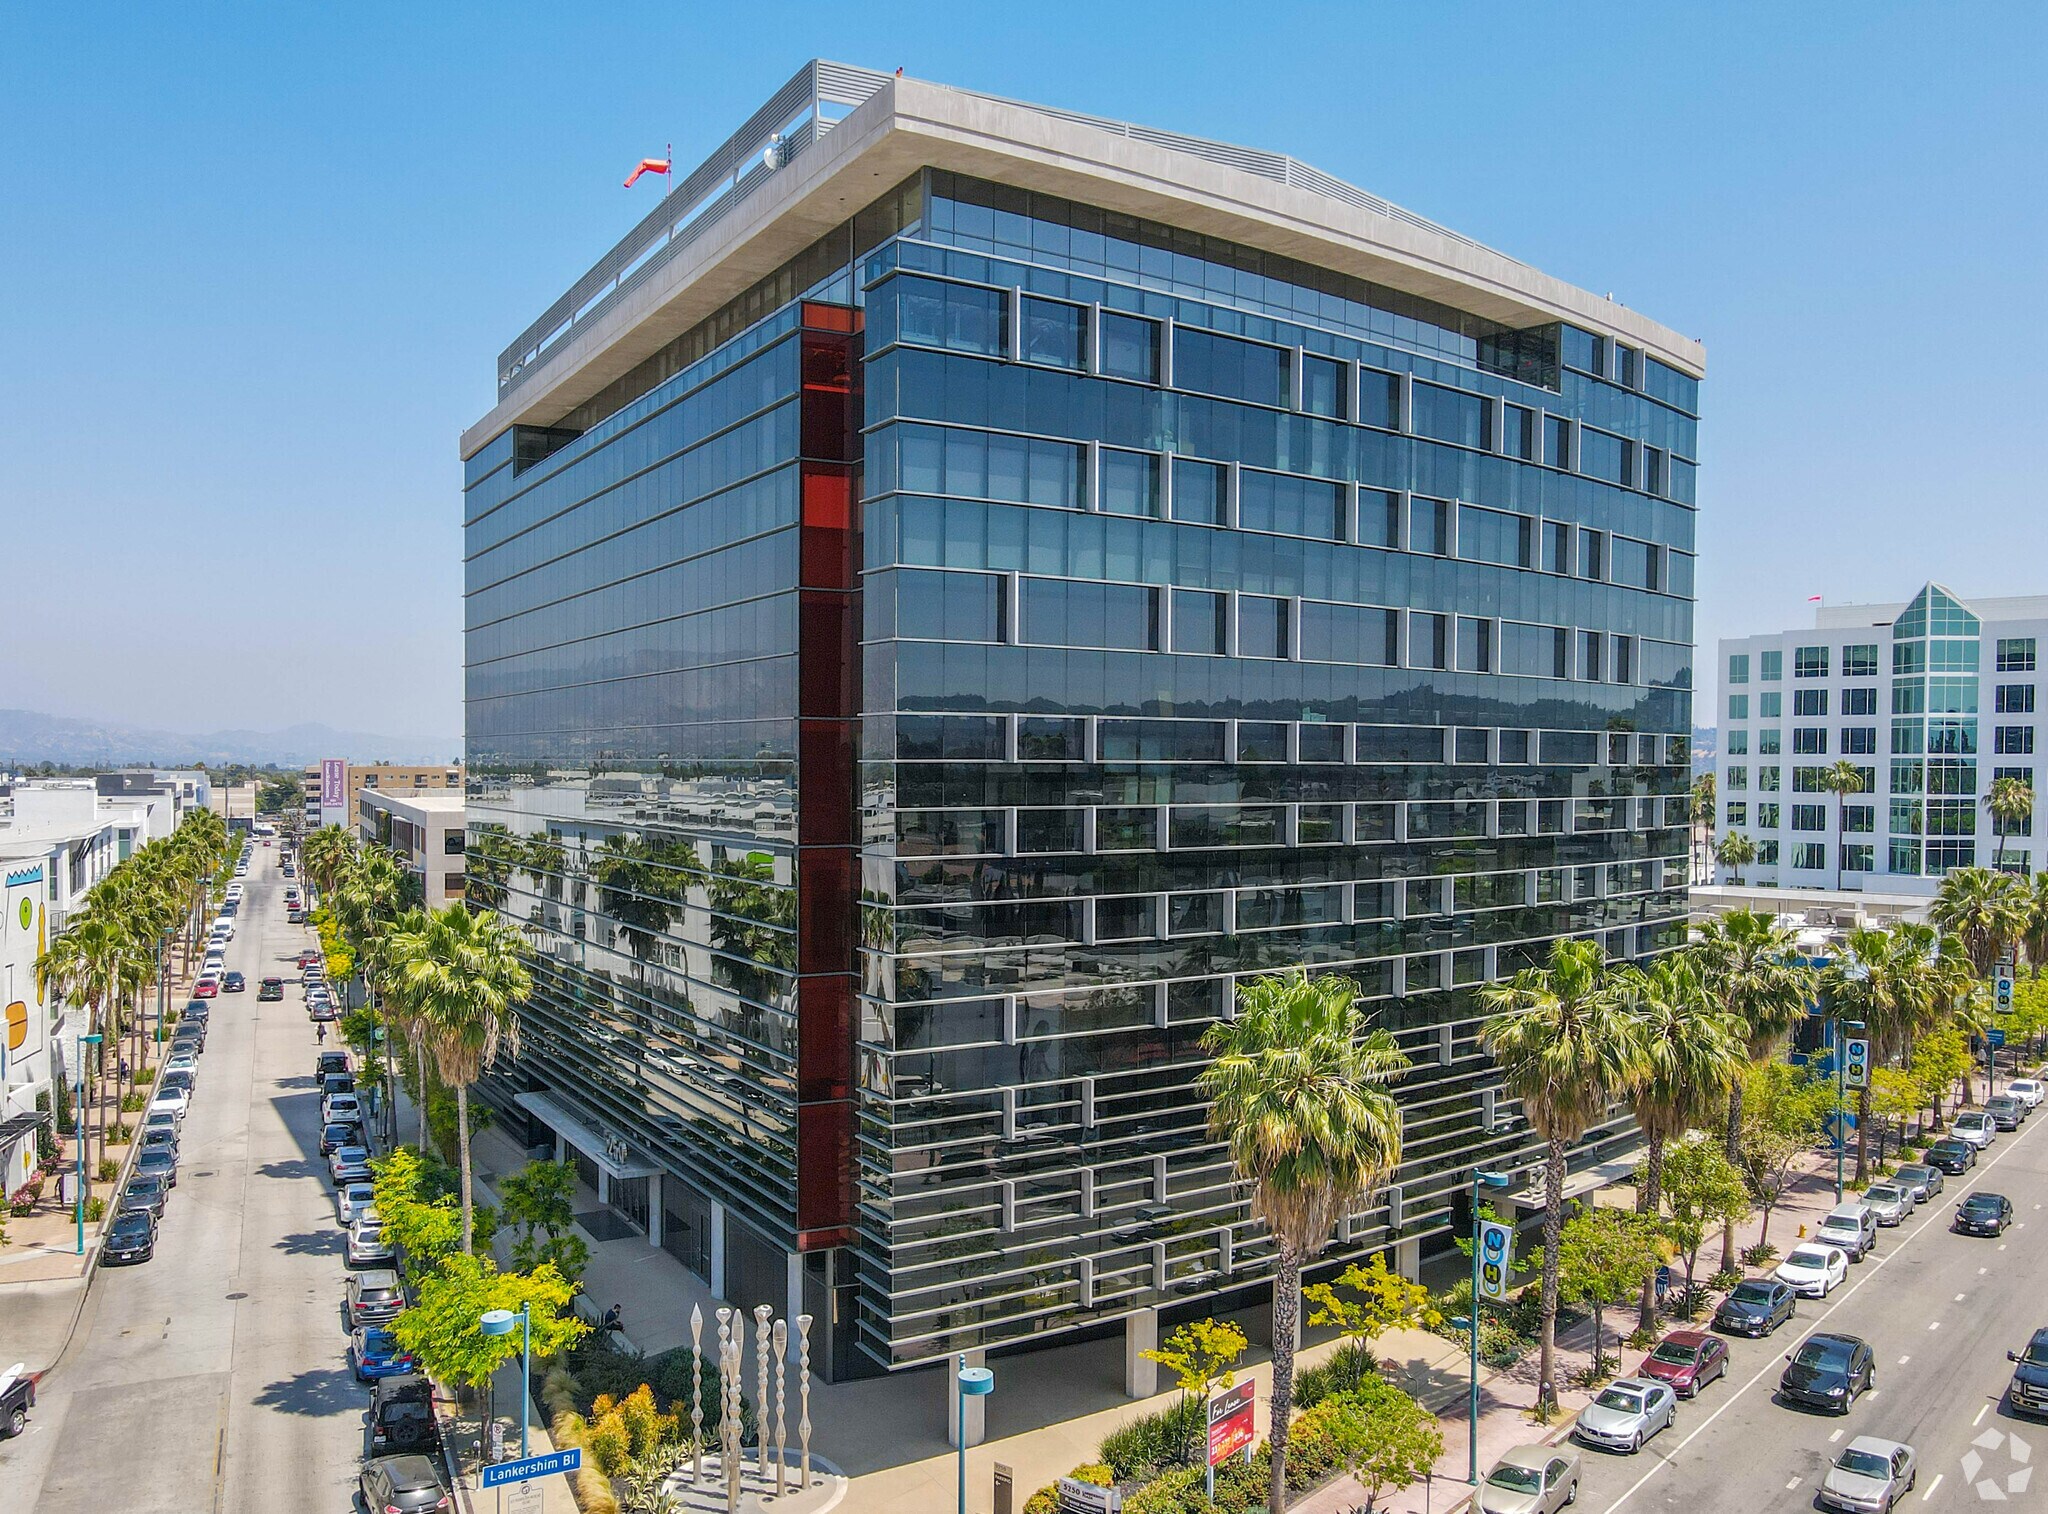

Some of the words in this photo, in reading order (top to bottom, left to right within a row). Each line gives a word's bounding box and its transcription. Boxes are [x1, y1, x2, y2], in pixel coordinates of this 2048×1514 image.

[1212, 1403, 1223, 1419] For
[1224, 1398, 1240, 1414] Lease
[490, 1460, 557, 1481] Lankershim
[1063, 1483, 1080, 1496] 5250
